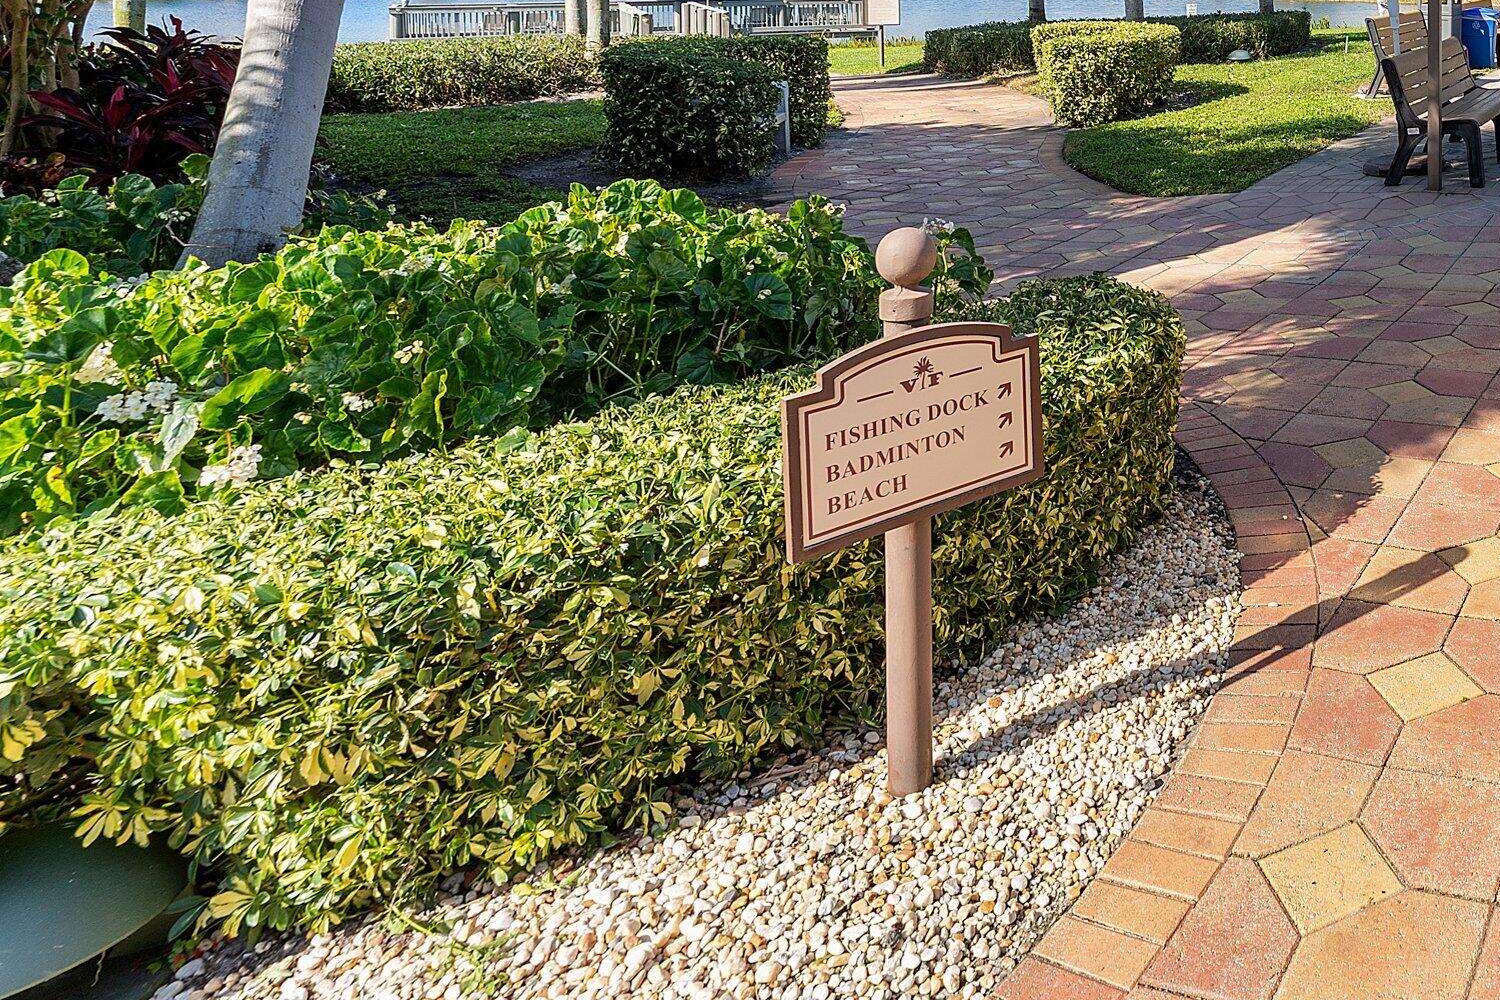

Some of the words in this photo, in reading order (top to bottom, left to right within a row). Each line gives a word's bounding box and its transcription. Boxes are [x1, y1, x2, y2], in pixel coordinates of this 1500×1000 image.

[824, 409, 922, 451] FISHING
[927, 389, 989, 422] DOCK
[825, 425, 967, 484] BADMINTON
[826, 473, 909, 516] BEACH
